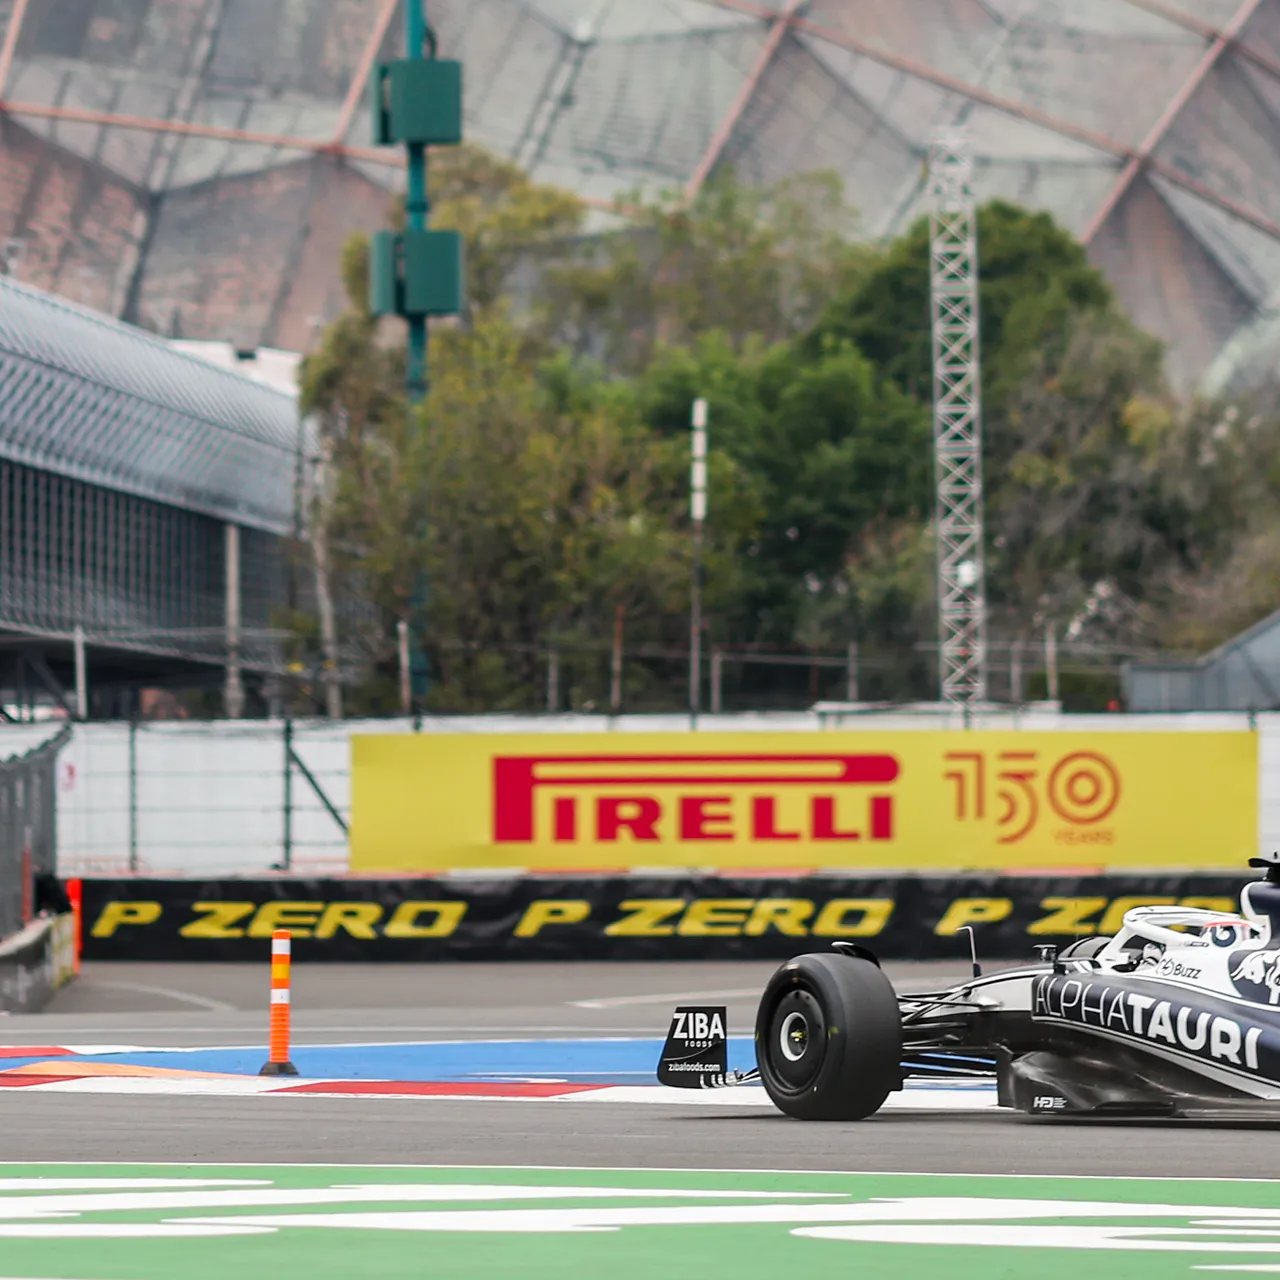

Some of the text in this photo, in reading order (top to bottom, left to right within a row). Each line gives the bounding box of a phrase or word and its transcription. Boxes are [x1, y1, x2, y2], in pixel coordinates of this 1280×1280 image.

[492, 753, 900, 843] PIRELLI
[90, 901, 468, 938] P ZERO
[514, 898, 894, 937] P ZERO
[673, 1013, 725, 1039] ZIBA
[1035, 975, 1263, 1069] ALPHATAURI
[685, 1040, 712, 1048] FOODS
[668, 1062, 720, 1072] zibafoods.com
